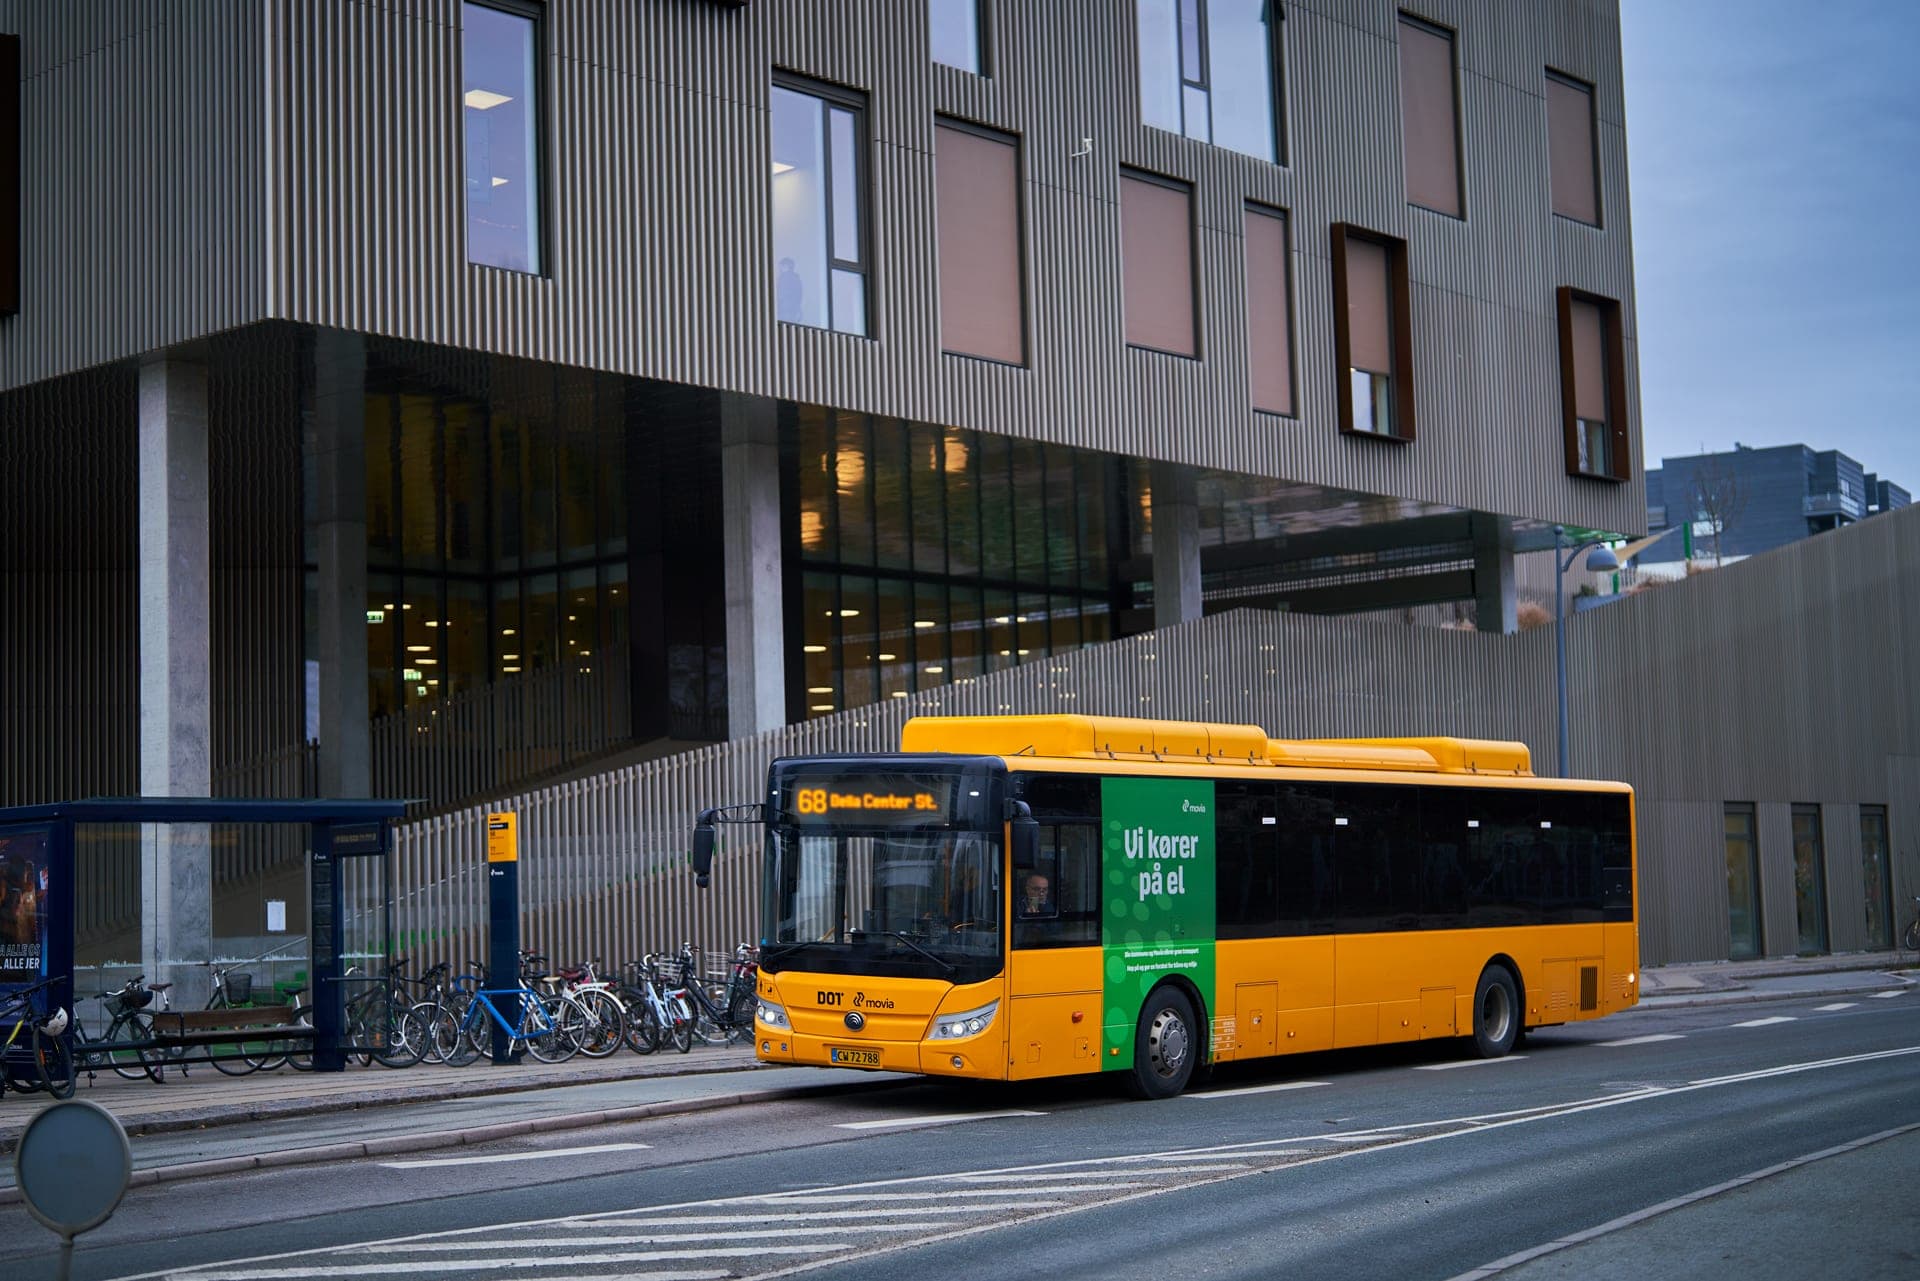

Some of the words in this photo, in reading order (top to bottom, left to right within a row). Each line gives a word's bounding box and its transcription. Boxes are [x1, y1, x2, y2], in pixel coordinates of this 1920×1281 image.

[798, 788, 827, 814] 68
[863, 793, 912, 809] Center
[915, 793, 937, 810] St.
[1189, 803, 1206, 813] movia
[1124, 826, 1143, 859] Vi
[1148, 829, 1199, 859] kører
[1139, 862, 1163, 901] på
[1167, 865, 1185, 895] el
[3, 957, 24, 970] ALLE
[25, 957, 40, 970] JER
[817, 991, 842, 1006] DOT
[866, 998, 895, 1009] movia
[837, 1050, 849, 1062] CW
[850, 1051, 861, 1063] 72
[863, 1052, 879, 1064] 788
